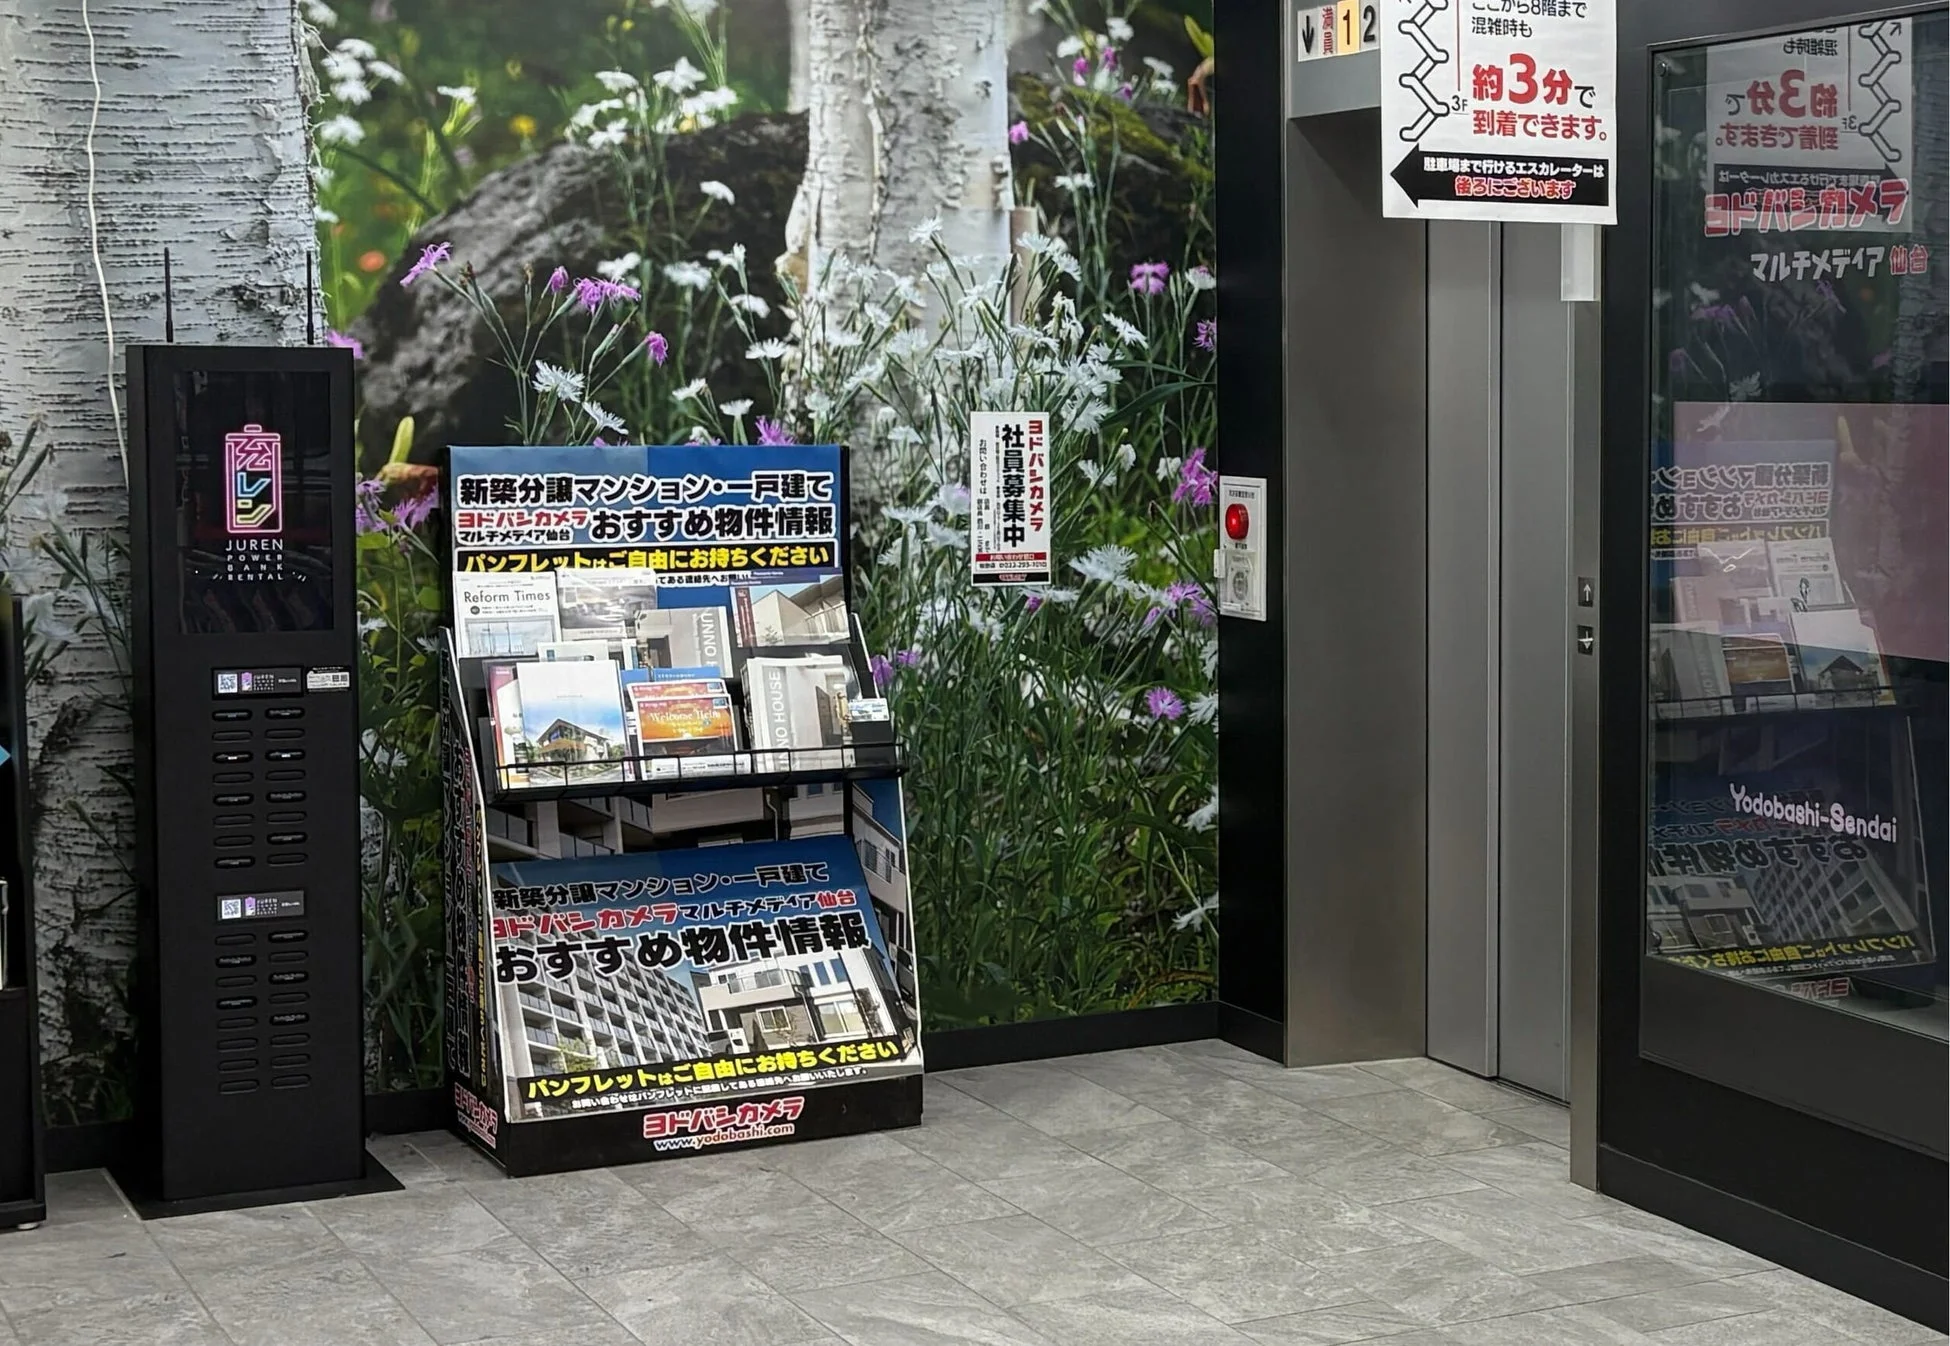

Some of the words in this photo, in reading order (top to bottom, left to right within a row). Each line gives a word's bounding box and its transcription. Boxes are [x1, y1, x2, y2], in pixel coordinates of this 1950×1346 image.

[1321, 6, 1334, 56] 満員
[1342, 8, 1351, 46] 1
[1363, 4, 1377, 43] 2
[1471, 16, 1533, 38] 混雑時も
[1472, 52, 1596, 109] 約3分で
[1451, 94, 1469, 112] 3F
[1472, 109, 1608, 142] 到着できます。
[1423, 157, 1605, 179] 駐車場まで行けるエスカレーターは
[1454, 176, 1577, 200] 後ろにございます
[1704, 177, 1909, 238] ヨドバシカメラ
[459, 473, 831, 504] 新築分譲マンション・一戸建て
[1001, 423, 1026, 548] 社員募集中
[1028, 419, 1045, 533] ヨドバシカメラ
[457, 509, 588, 529] ヨドバシカメラ
[591, 505, 833, 541] おすすめ物件情報
[225, 538, 284, 552] JUREN
[457, 529, 572, 543] マルチメディア仙台
[227, 553, 283, 562] POWER
[227, 563, 284, 572] BANK
[465, 545, 830, 571] パンフレットはご自由にお持ちください
[227, 573, 284, 581] RENTAL
[463, 590, 510, 604] Reform
[514, 589, 551, 602] Times
[768, 669, 785, 723] HOUSE
[1729, 782, 1898, 844] Yodobashi-Sendai
[496, 911, 870, 984] おすすめ物件情報
[527, 1041, 900, 1100] パンフレットはご自由にお持ちください
[643, 1096, 805, 1140] ヨドバシカメラ
[653, 1121, 795, 1151] www.yodobashi.com
